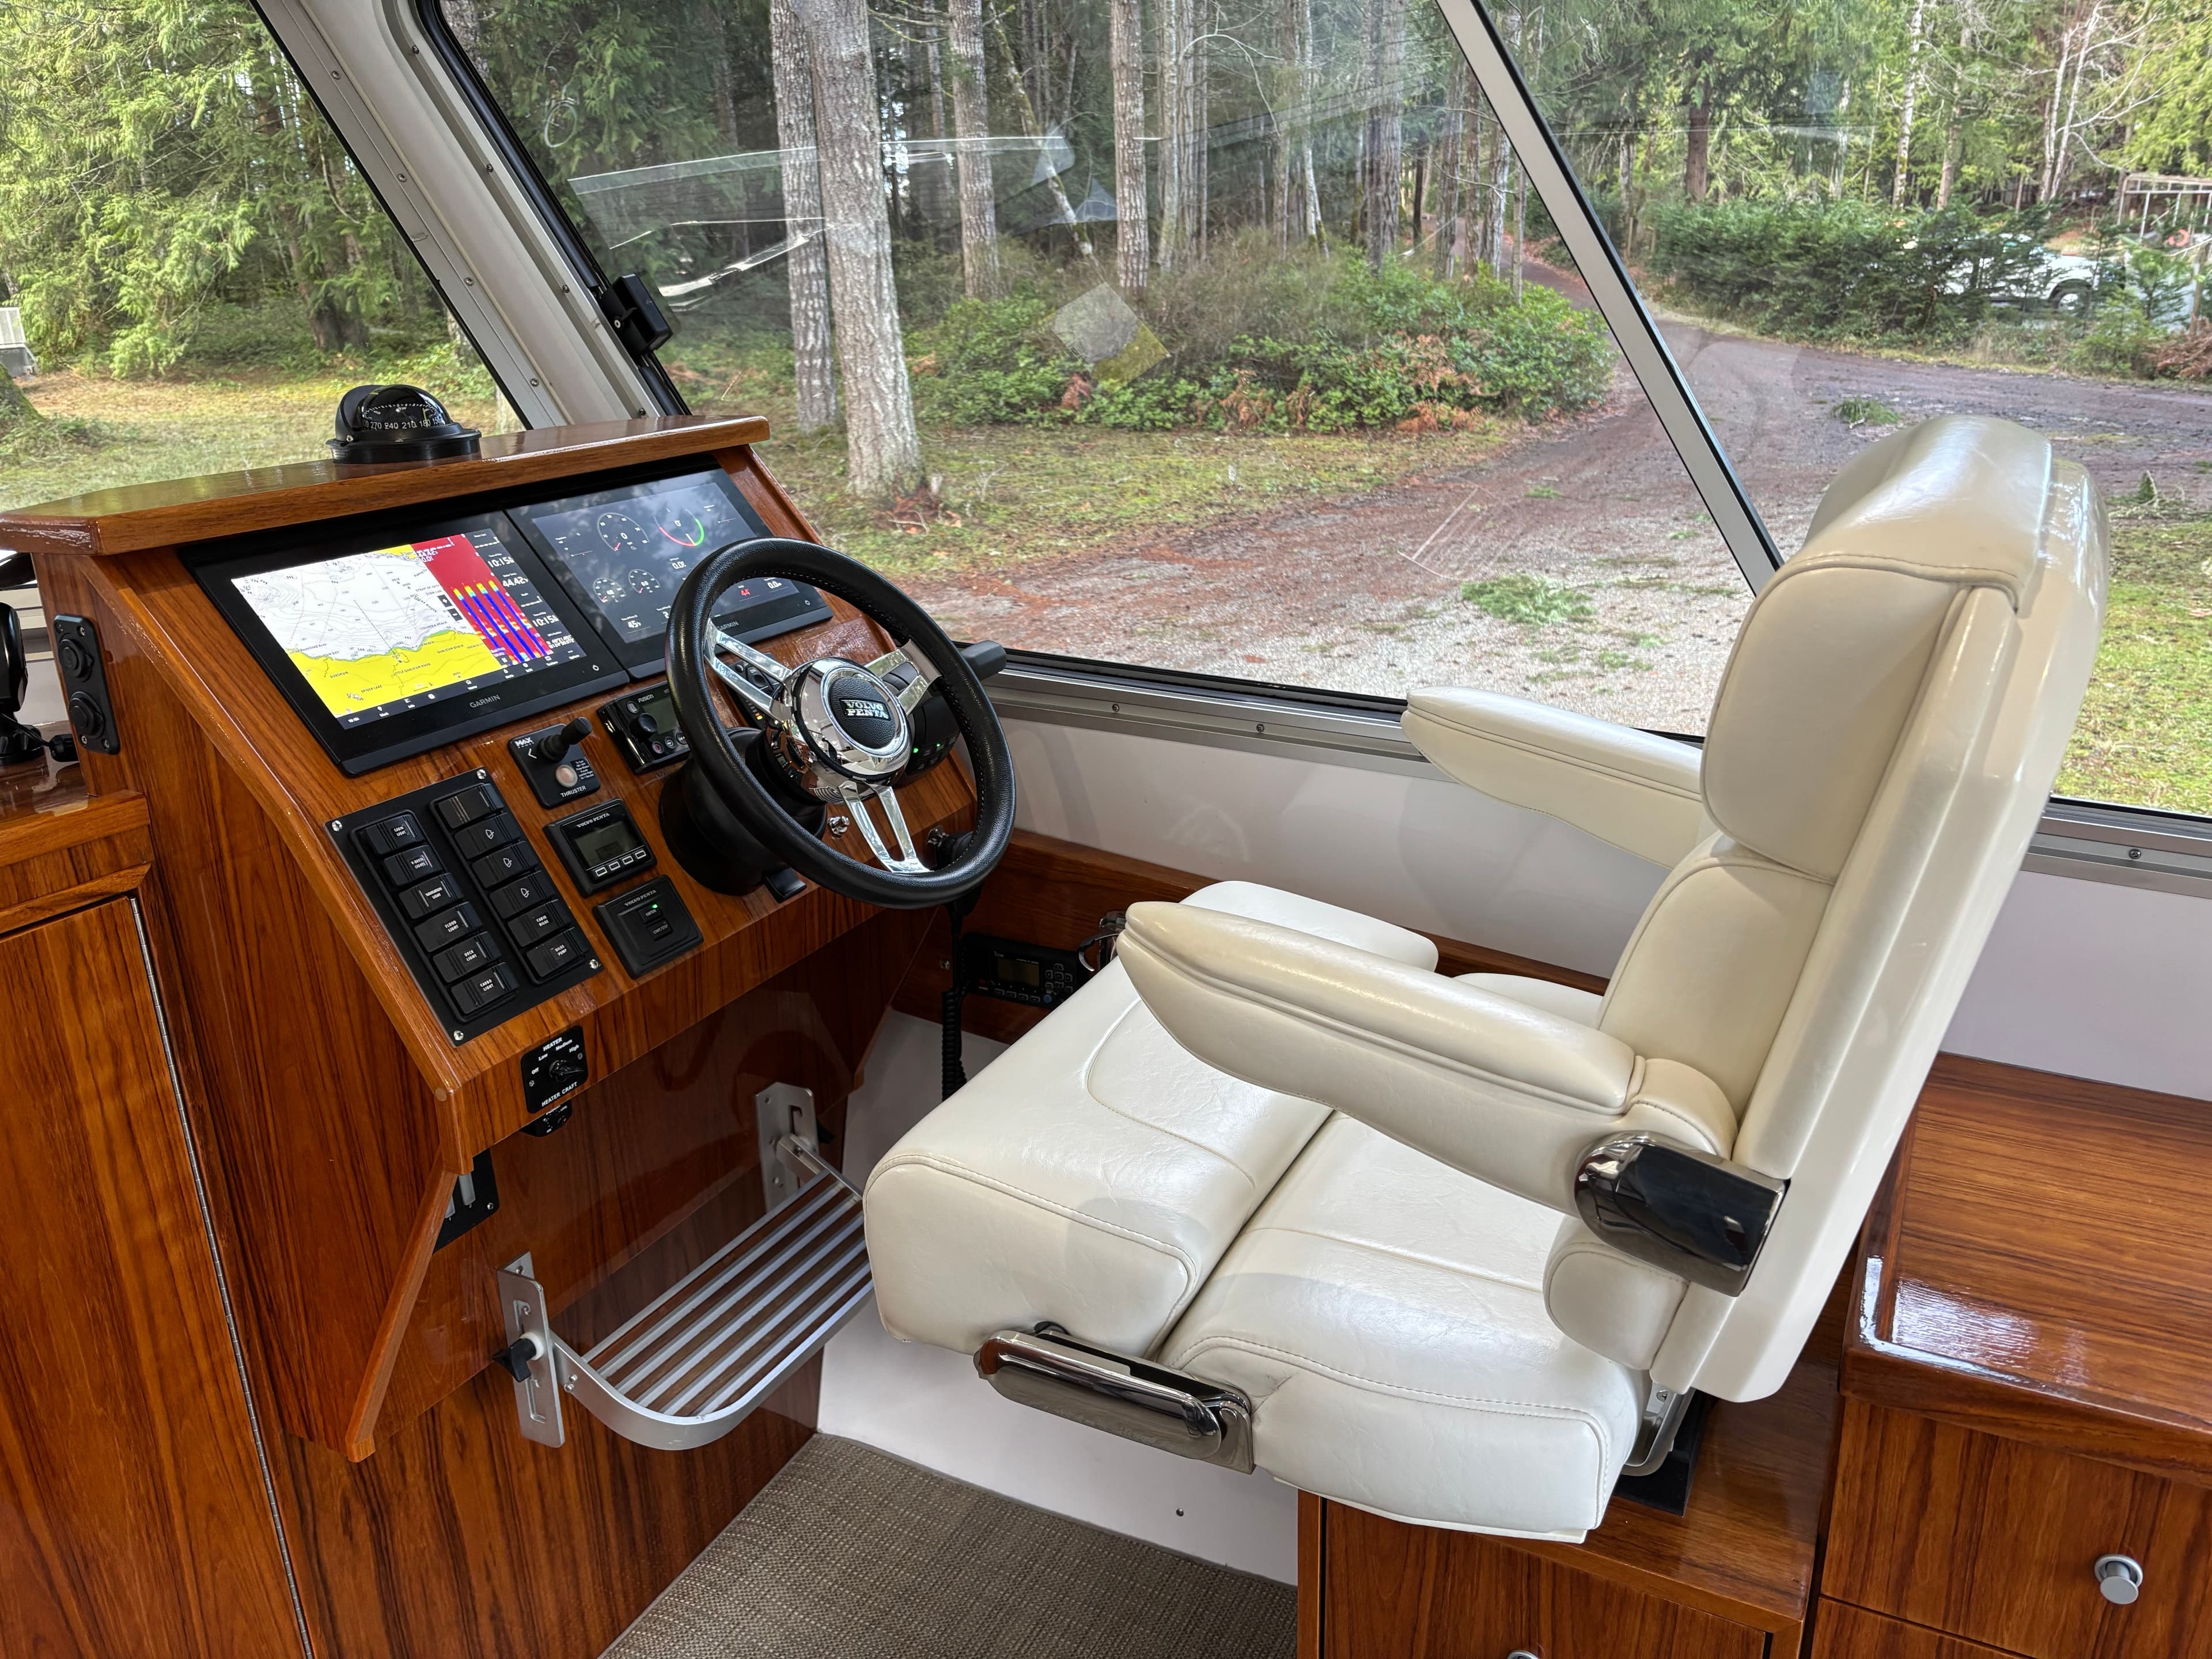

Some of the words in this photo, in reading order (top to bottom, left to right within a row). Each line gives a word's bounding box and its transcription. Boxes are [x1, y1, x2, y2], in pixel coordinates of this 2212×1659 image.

[469, 694, 501, 708] GARMIN
[638, 694, 654, 703] FUSION
[846, 701, 884, 711] VOLVO
[845, 709, 889, 719] PENTA
[514, 737, 533, 747] MAX
[560, 785, 586, 798] THRUSTER
[576, 819, 593, 828] VOLVO
[593, 813, 611, 821] PENTA
[624, 897, 641, 906] VOLVO
[640, 889, 657, 899] PENTA
[444, 920, 457, 929] FLOOD
[448, 924, 459, 933] LIGHT
[465, 953, 478, 961] LIGHT
[480, 979, 493, 987] CARGO
[483, 983, 494, 991] LIGHT
[543, 1037, 563, 1052] HEATER
[555, 1039, 573, 1051] Medium
[569, 1044, 579, 1053] High
[538, 1053, 548, 1062] Low
[531, 1067, 540, 1075] Off
[541, 1092, 561, 1107] HEATER
[561, 1081, 578, 1094] CRAFT
